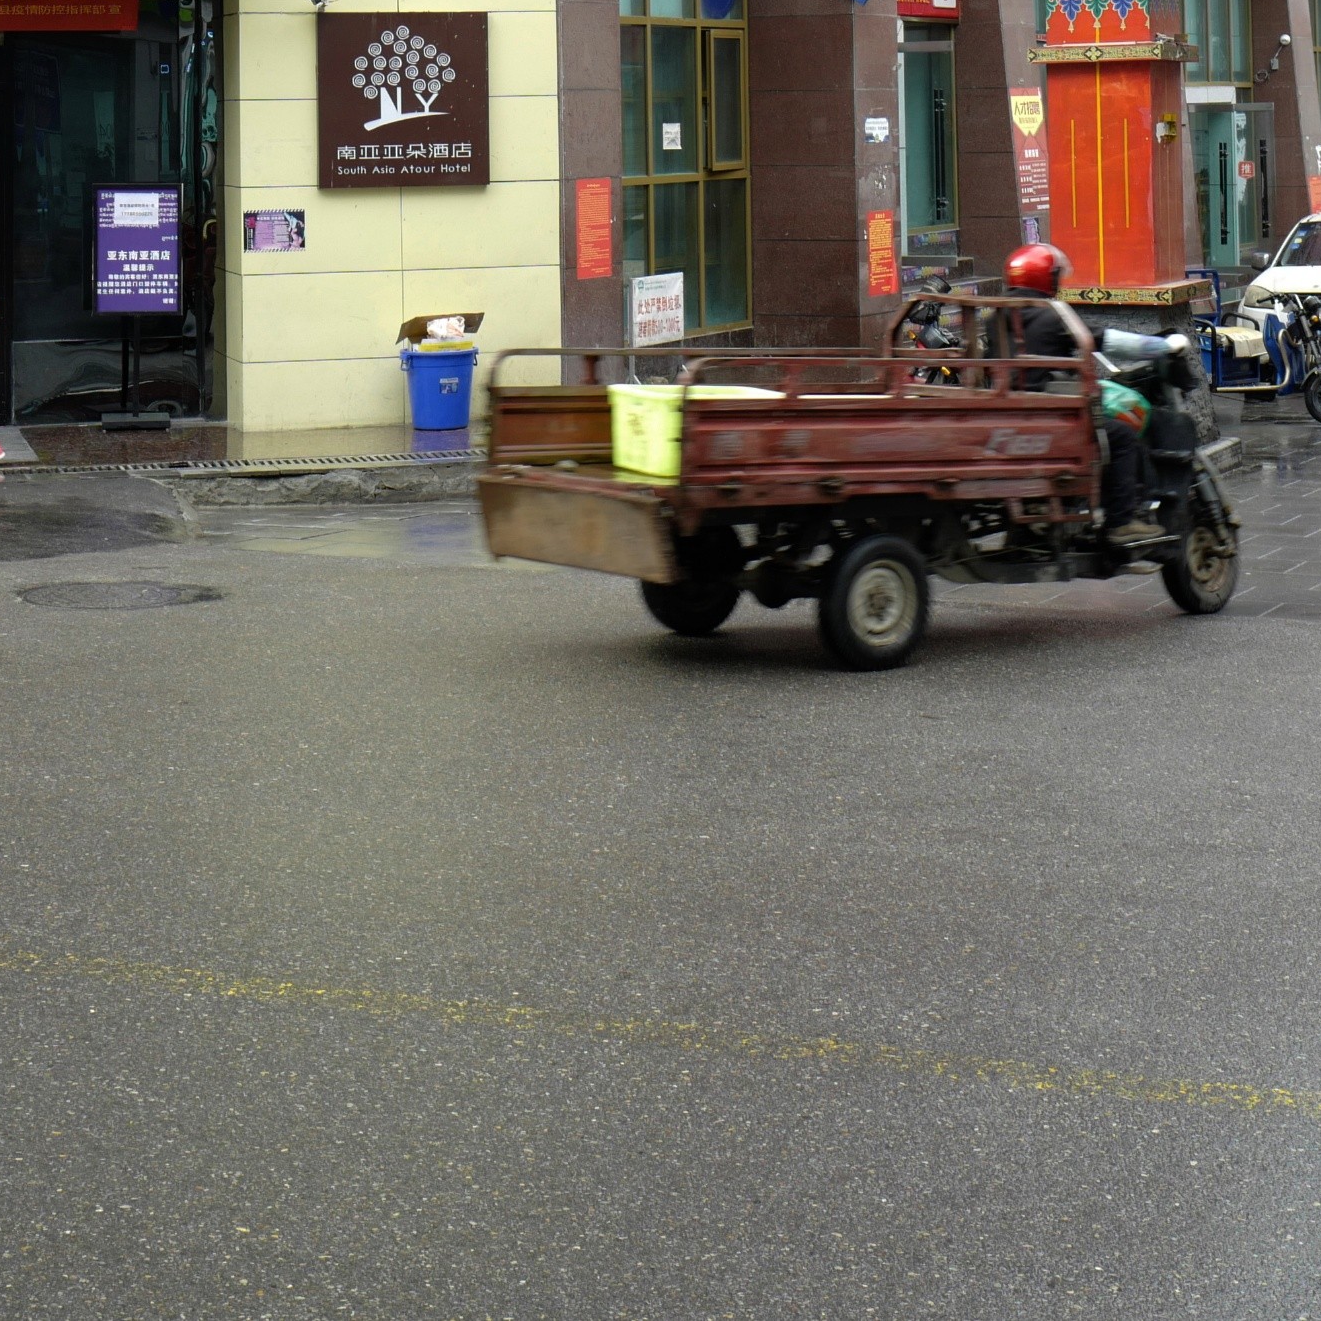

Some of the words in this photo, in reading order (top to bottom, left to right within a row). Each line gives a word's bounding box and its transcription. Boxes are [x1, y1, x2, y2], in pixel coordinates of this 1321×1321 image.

[1014, 101, 1040, 115] 人才招聘
[337, 142, 472, 160] 南亚亚朵酒店
[337, 164, 367, 176] South
[372, 163, 395, 175] Asia
[400, 163, 436, 175] Atour
[440, 162, 471, 174] Hotel
[107, 250, 171, 261] 亚东南亚酒店
